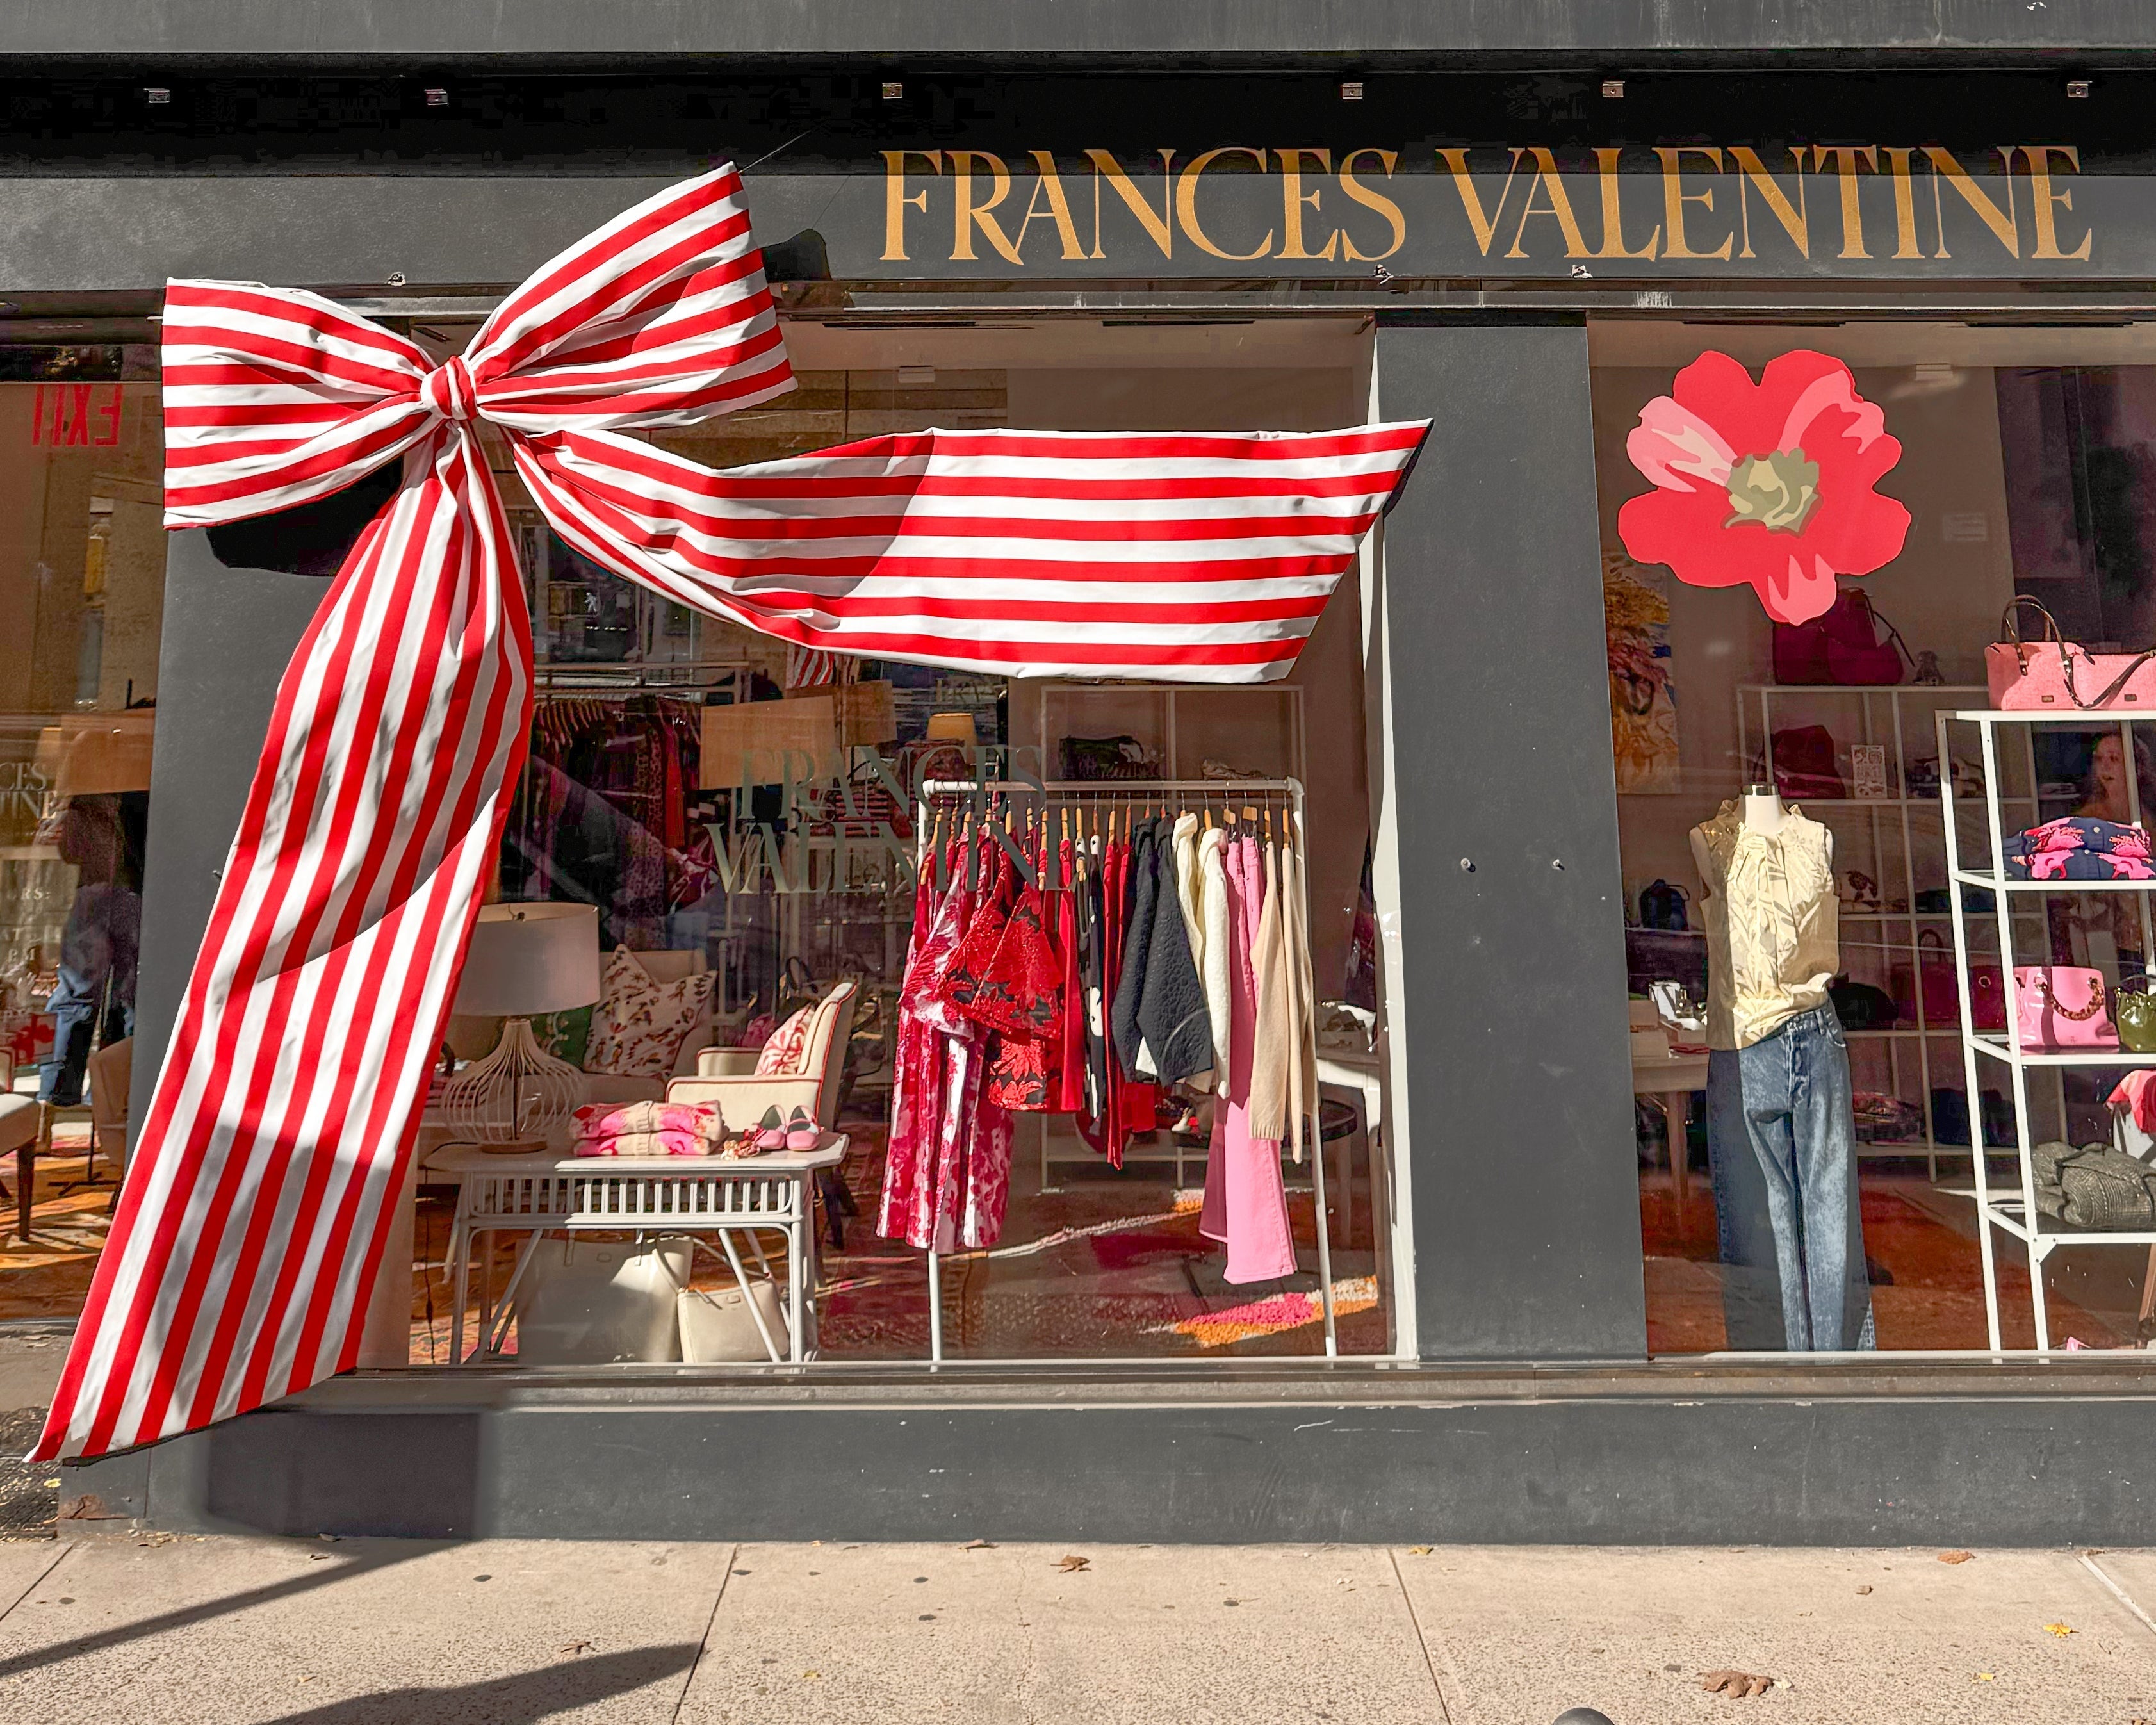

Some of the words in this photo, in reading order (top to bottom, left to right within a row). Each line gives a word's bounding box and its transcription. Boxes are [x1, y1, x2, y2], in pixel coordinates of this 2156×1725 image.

[879, 147, 1406, 266] FRANCES
[1435, 145, 2093, 261] VALENTINE
[739, 745, 1047, 821] FRANCES
[703, 817, 1079, 894] VALENTINE
